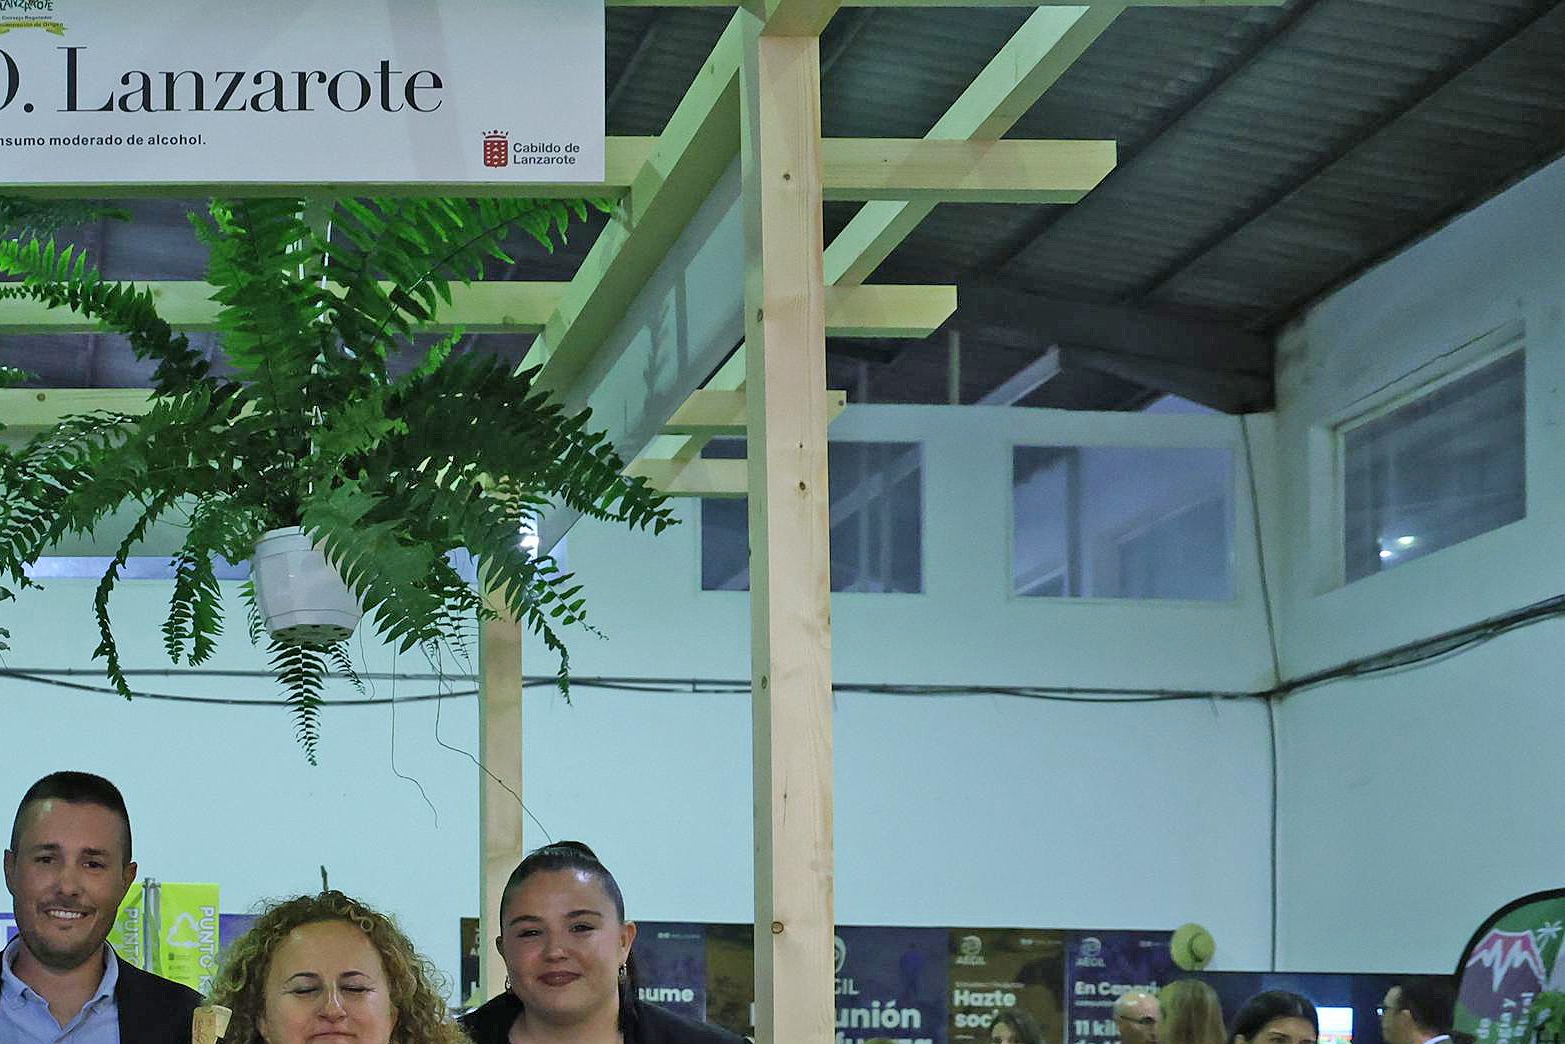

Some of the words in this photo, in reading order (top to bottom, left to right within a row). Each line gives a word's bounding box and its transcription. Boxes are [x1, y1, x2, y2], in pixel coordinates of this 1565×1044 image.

[57, 46, 443, 112] Lanzarote
[49, 134, 123, 146] moderado
[126, 134, 144, 145] de
[147, 133, 206, 145] alcohol.
[513, 142, 561, 153] Cabildo
[565, 142, 580, 153] de
[513, 154, 576, 165] Lanzarote
[199, 906, 214, 969] PUNTO
[1075, 981, 1096, 996] En
[953, 989, 1016, 1007] Hazte
